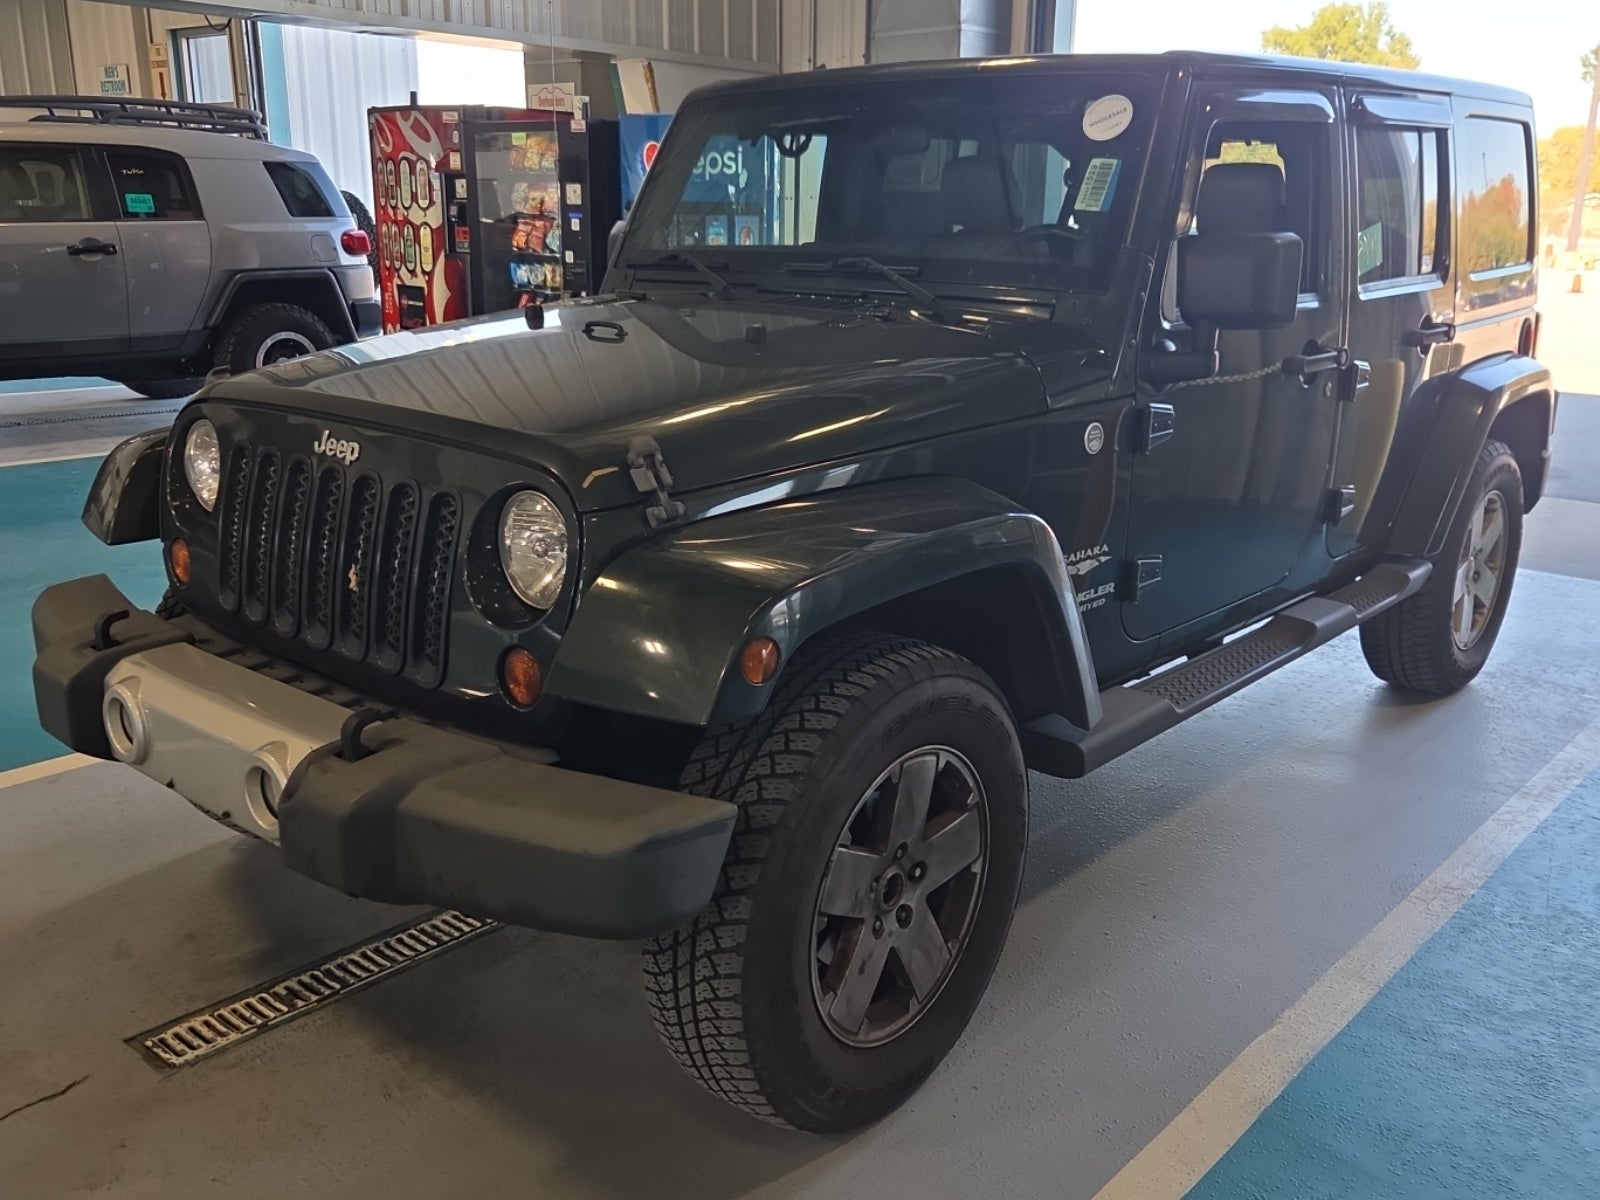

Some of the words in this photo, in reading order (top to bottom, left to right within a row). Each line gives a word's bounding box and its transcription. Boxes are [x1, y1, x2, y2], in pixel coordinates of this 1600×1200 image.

[1088, 107, 1127, 127] WHOLESALE
[692, 145, 744, 181] epsi
[313, 429, 360, 466] Jeep
